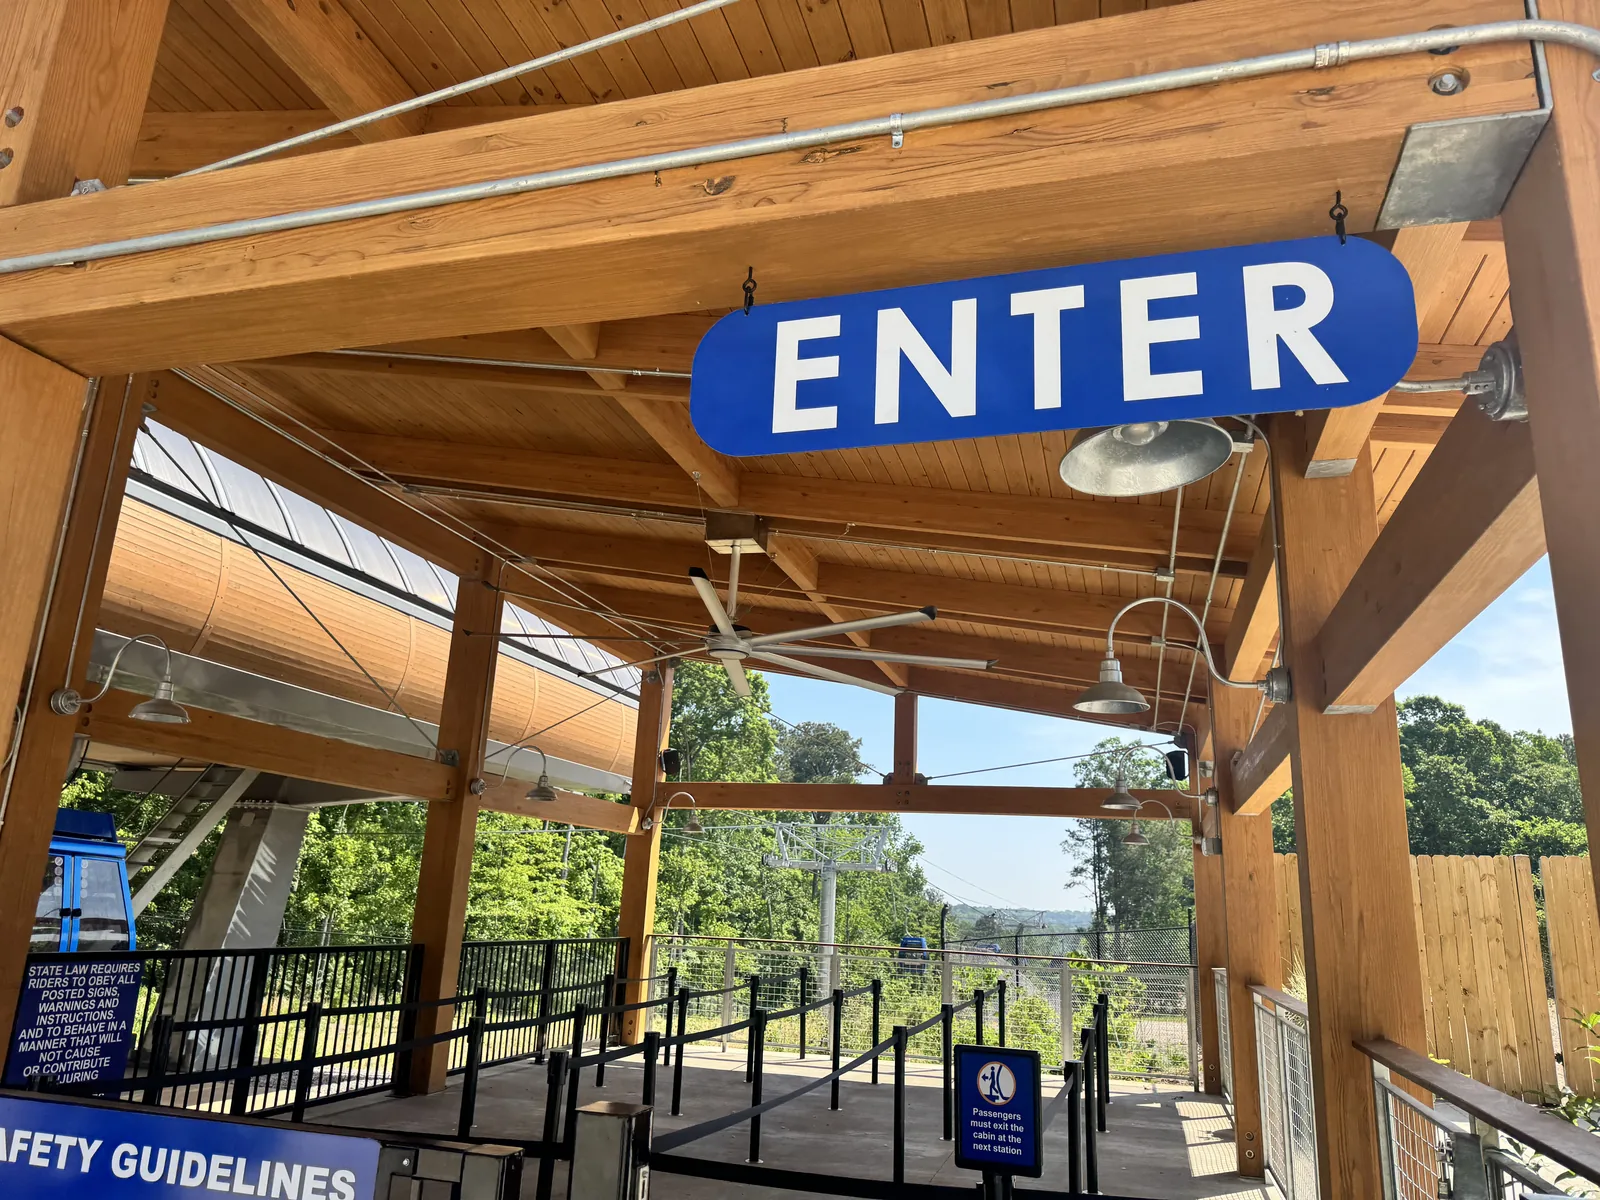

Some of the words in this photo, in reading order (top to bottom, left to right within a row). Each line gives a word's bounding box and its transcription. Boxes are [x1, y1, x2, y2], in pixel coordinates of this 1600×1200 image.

[771, 261, 1350, 434] ENTER
[28, 966, 62, 976] STATE
[65, 965, 88, 975] LAW
[90, 963, 140, 974] REQUIRES
[28, 977, 69, 989] RIDERS
[72, 976, 86, 986] TO
[88, 976, 117, 985] OBEY
[117, 975, 135, 984] ALL
[42, 988, 85, 1000] POSTED
[87, 987, 120, 998] SIGNS,
[38, 1000, 96, 1013] WARNINGS
[98, 998, 119, 1008] AND
[18, 1029, 43, 1040] AND
[47, 1027, 61, 1038] TO
[64, 1022, 105, 1036] BEHAVE
[108, 1021, 118, 1031] IN
[119, 1021, 126, 1030] A
[19, 1038, 66, 1052] MANNER
[70, 1035, 97, 1046] THAT
[99, 1033, 122, 1044] WILL
[39, 1051, 62, 1062] NOT
[65, 1046, 101, 1059] CAUSE
[23, 1066, 39, 1077] OR
[42, 1057, 111, 1074] CONTRIBUTE
[57, 1070, 99, 1084] JURING
[973, 1108, 1021, 1121] Passengers
[971, 1120, 991, 1129] must
[993, 1122, 1009, 1130] exit
[1010, 1123, 1024, 1132] the
[973, 1131, 996, 1140] cabin
[1008, 1134, 1021, 1143] the
[973, 1143, 991, 1151] next
[993, 1145, 1022, 1155] station
[111, 1142, 356, 1200] GUIDELINES
